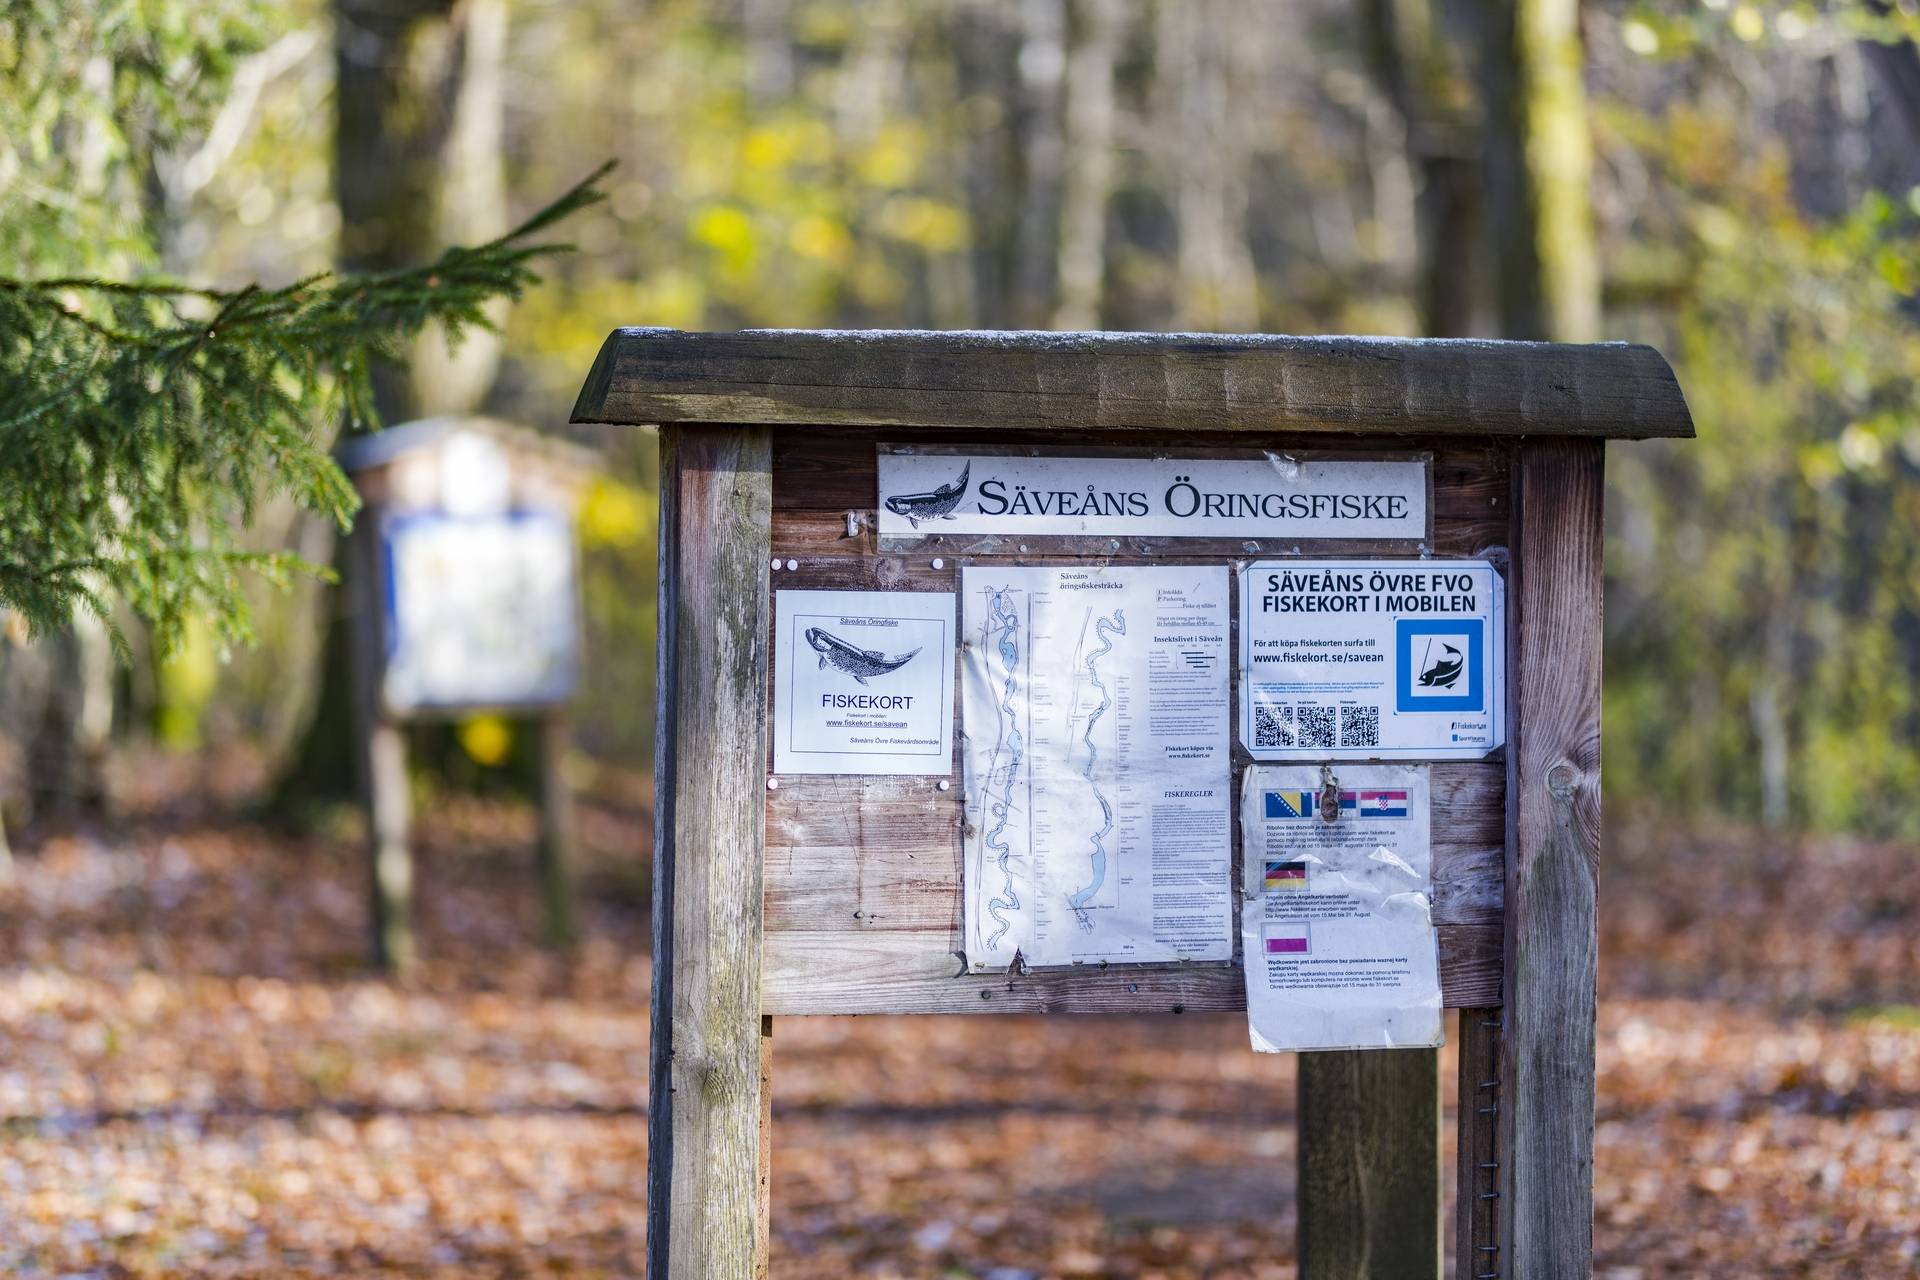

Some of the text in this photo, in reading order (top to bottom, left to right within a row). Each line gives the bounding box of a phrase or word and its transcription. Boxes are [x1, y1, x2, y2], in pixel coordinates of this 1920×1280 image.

[978, 475, 1408, 519] SÄVEÅNS ÖRINGSFISKE
[1060, 582, 1123, 590] öringsfiskesträcka
[1268, 569, 1473, 592] SÄVEÅNS ÖVRE FVO
[1263, 595, 1476, 612] FISKEKORT I MOBILEN
[1254, 639, 1266, 647] För
[1280, 640, 1298, 648] köpa
[1300, 639, 1342, 647] fiskekorten
[1344, 639, 1363, 647] surfa
[1365, 639, 1375, 647] till
[1254, 652, 1384, 663] www.fiskekort.se/savean
[822, 694, 913, 709] FISKEKORT
[826, 719, 908, 728] www.fiskekort.se/savean
